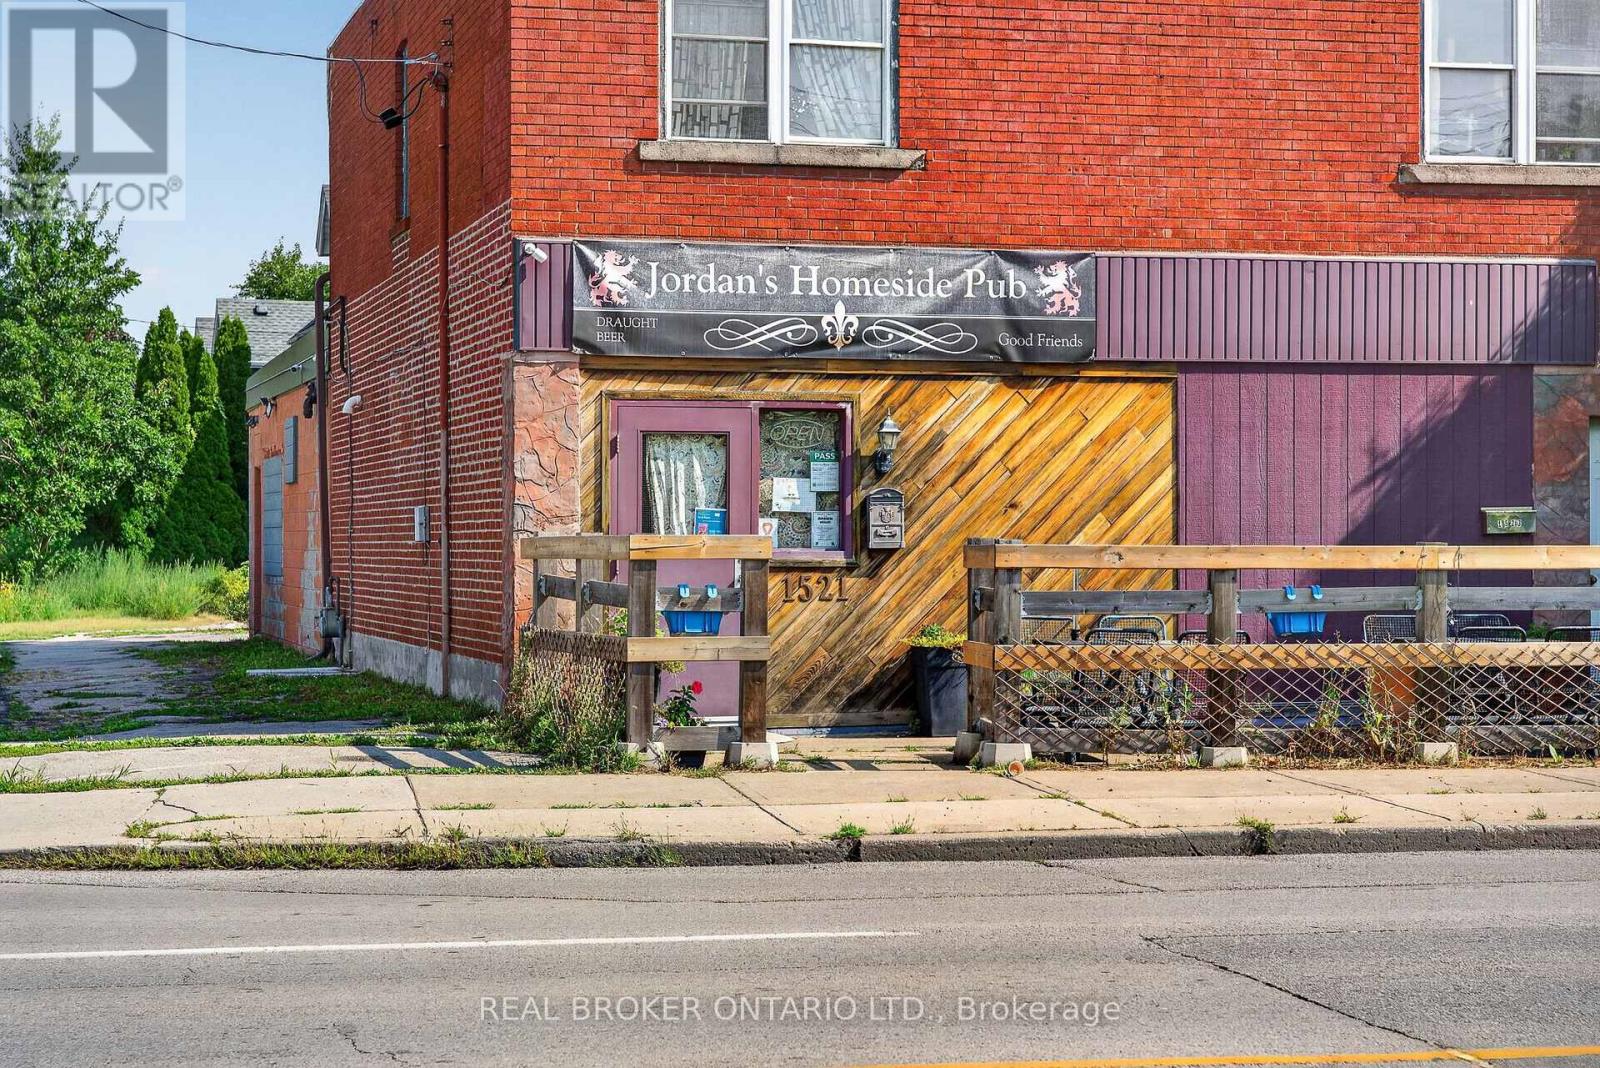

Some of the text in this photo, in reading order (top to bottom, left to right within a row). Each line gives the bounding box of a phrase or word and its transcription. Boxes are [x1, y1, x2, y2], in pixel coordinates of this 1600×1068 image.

[645, 261, 1027, 299] Jordan's Homeside Pub
[596, 316, 659, 329] DRAUGHT
[596, 331, 626, 343] BEER
[998, 332, 1083, 348] Good Friends
[770, 425, 825, 441] OPEN
[814, 452, 836, 460] PASS
[781, 575, 848, 603] 1521
